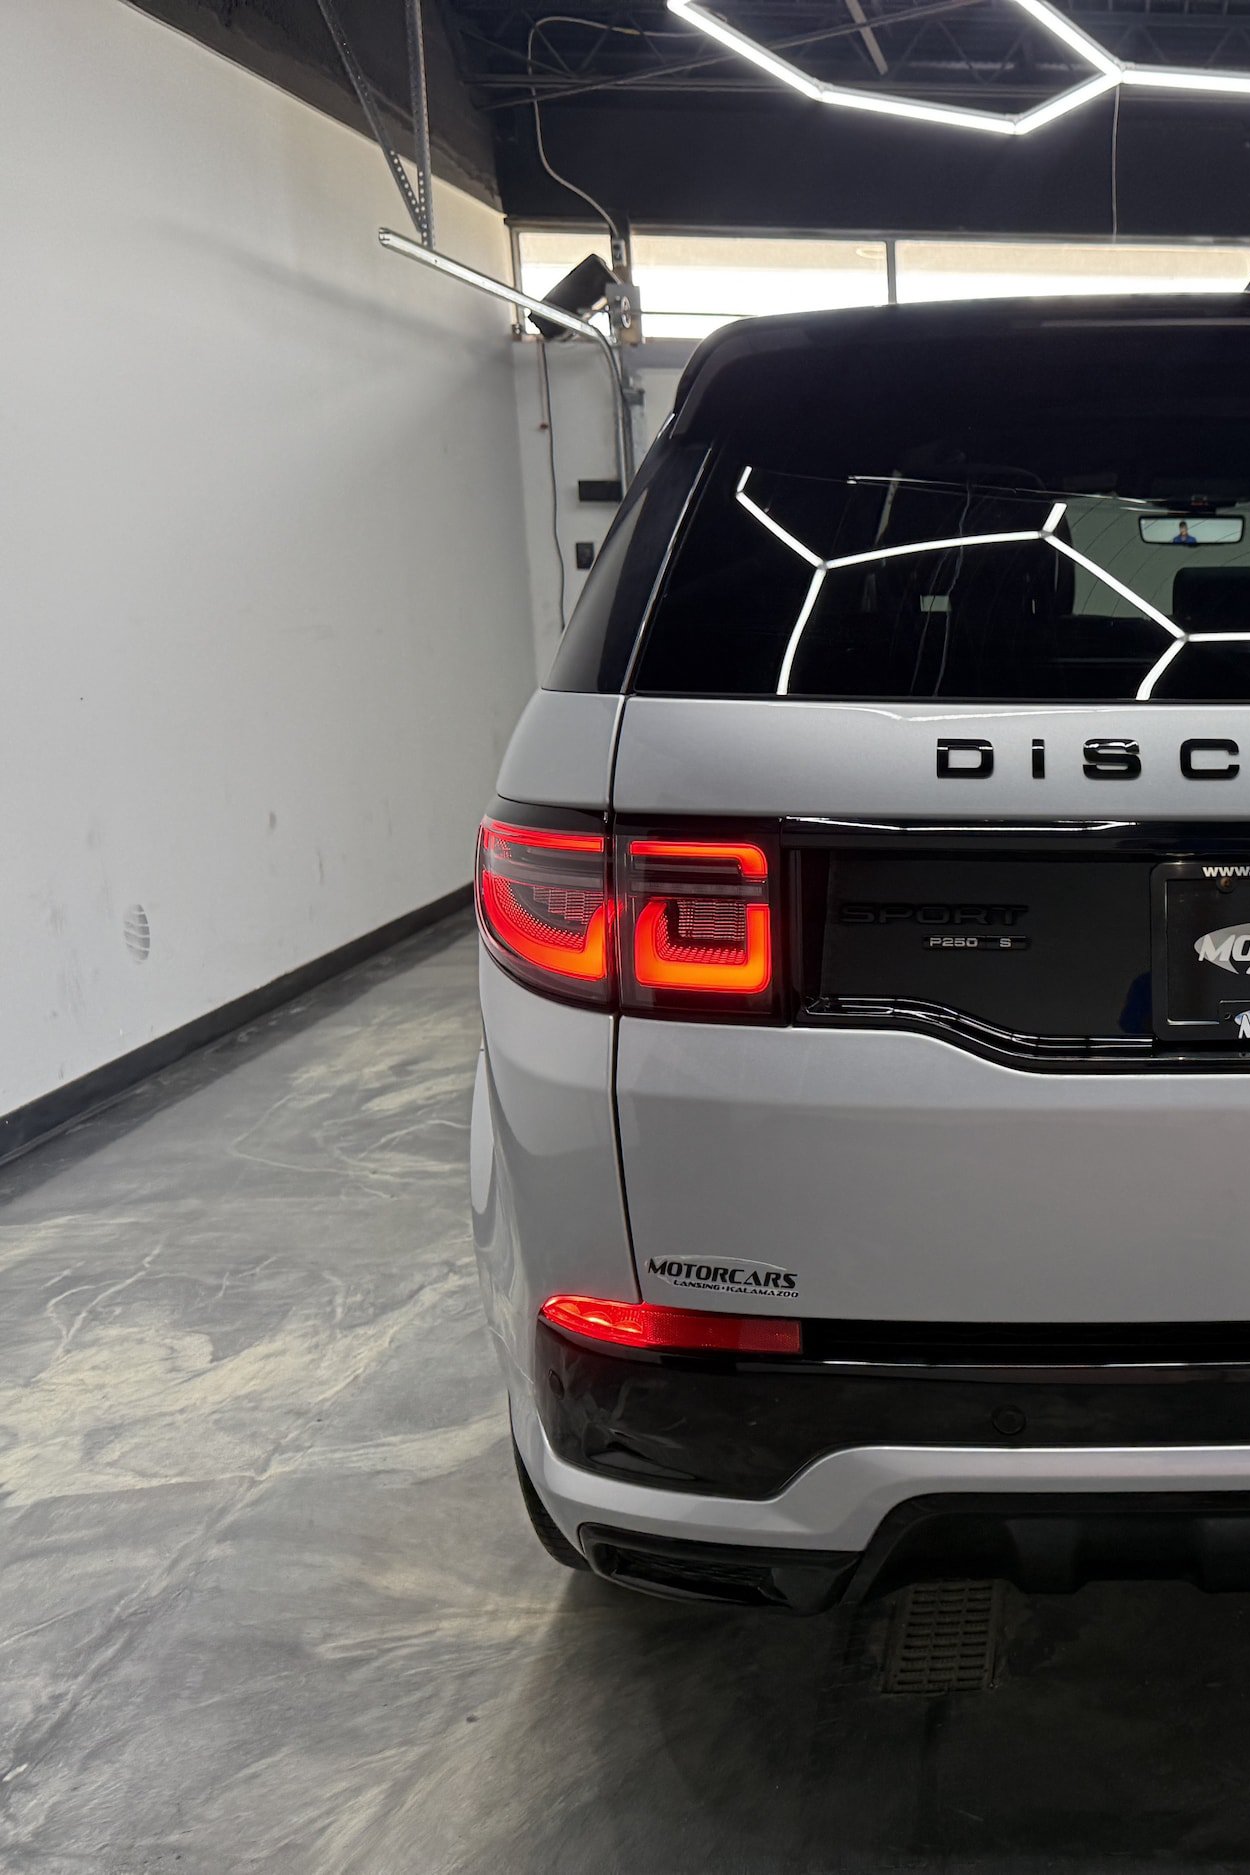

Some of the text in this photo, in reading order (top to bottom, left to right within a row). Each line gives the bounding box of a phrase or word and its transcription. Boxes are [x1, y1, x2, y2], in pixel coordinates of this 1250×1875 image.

[840, 904, 1029, 926] SPORT
[929, 937, 1012, 948] P250 S
[648, 1258, 798, 1289] MOTORCARS
